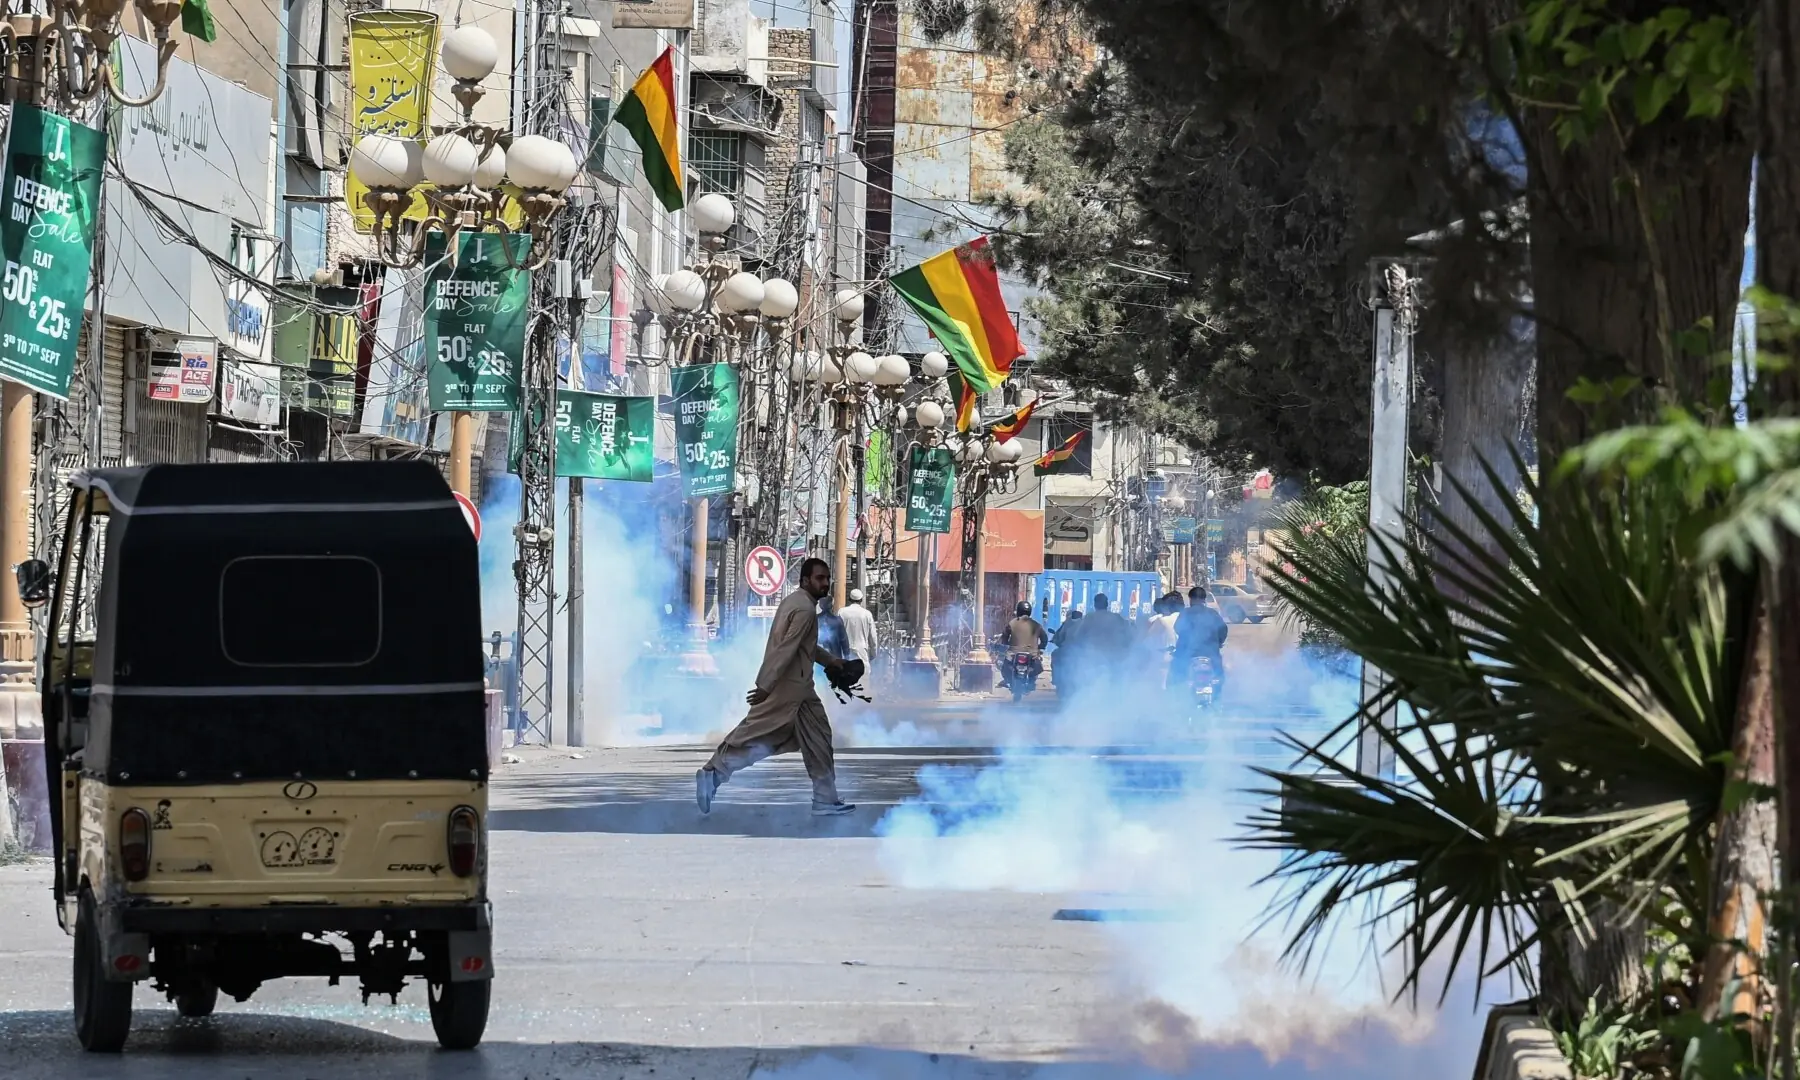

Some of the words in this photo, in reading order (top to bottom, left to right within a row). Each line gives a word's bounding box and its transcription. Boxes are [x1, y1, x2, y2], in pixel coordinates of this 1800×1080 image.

[14, 174, 73, 217] DEFENCE
[11, 202, 32, 225] DAY
[28, 202, 83, 243] Sale
[32, 249, 54, 269] FLAT
[435, 279, 500, 297] DEFENCE
[28, 301, 37, 319] &
[435, 297, 458, 310] DAY
[456, 292, 517, 317] Sale
[464, 323, 486, 334] FLAT
[16, 338, 28, 354] TO
[40, 347, 61, 366] SEPT
[185, 355, 209, 369] Ria
[467, 356, 476, 369] &
[184, 371, 209, 381] ACE
[459, 384, 470, 394] TO
[485, 383, 507, 394] SEPT
[591, 402, 603, 420] DAY
[681, 398, 720, 414] DEFENCE
[682, 415, 696, 425] DAY
[695, 409, 729, 428] Sale
[571, 425, 581, 444] FLAT
[601, 403, 617, 457] DEFENCE
[701, 430, 714, 440] FLAT
[585, 419, 605, 469] Sale
[913, 468, 941, 479] DEFENCE
[758, 556, 773, 578] P
[386, 863, 427, 871] CNG
